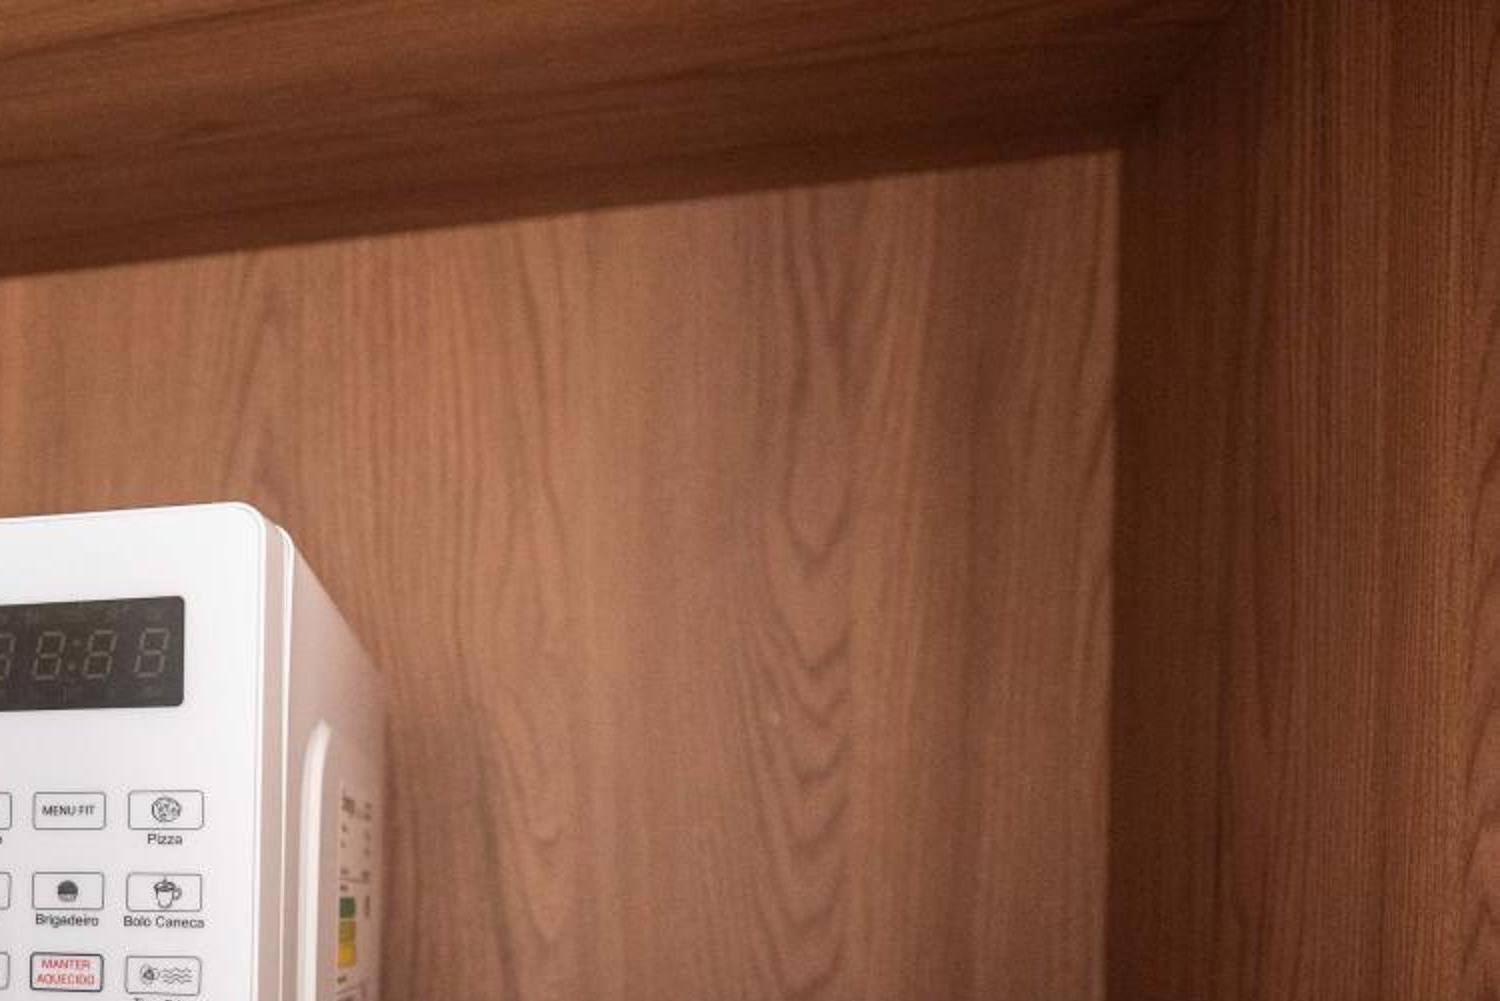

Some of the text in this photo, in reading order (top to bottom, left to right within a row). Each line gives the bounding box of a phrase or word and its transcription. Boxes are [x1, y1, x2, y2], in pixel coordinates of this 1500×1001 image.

[42, 804, 96, 817] MENU FIT
[147, 833, 184, 846] Pizza
[34, 912, 100, 928] Brigadeiro
[123, 915, 205, 929] Bolo Caneca
[41, 958, 91, 972] MANTER
[36, 973, 96, 987] AQUECIDO
